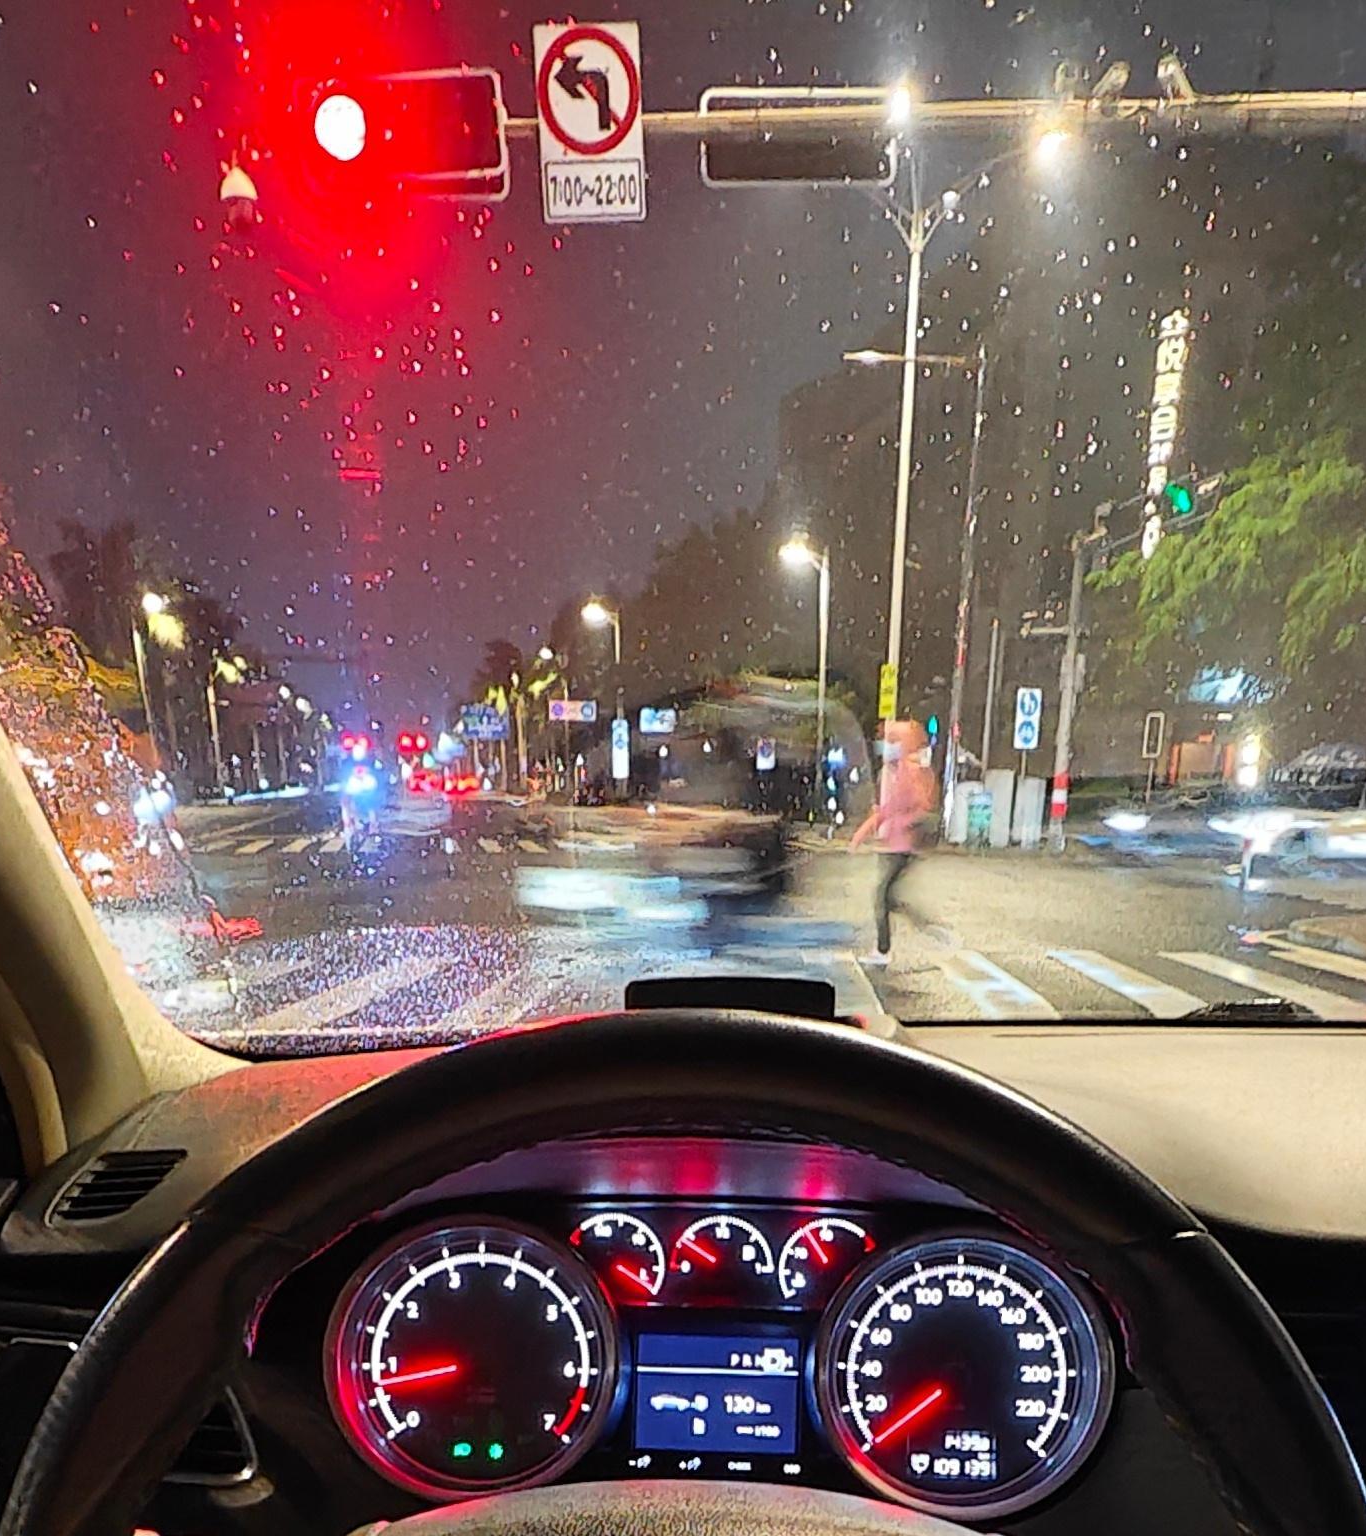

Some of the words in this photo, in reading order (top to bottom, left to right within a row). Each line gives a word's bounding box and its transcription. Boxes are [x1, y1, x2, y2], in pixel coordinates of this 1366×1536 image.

[550, 174, 636, 206] 7:00~22:00
[448, 1272, 461, 1289] 3
[503, 1273, 516, 1290] 4
[947, 1279, 974, 1298] 120
[914, 1287, 943, 1306] 100
[976, 1289, 1005, 1307] 140
[406, 1301, 420, 1319] 2
[546, 1304, 559, 1322] 5
[889, 1304, 912, 1322] 80
[999, 1307, 1027, 1325] 160
[870, 1328, 893, 1347] 60
[387, 1356, 398, 1374] 1
[563, 1361, 577, 1378] 6
[860, 1359, 883, 1378] 40
[1020, 1364, 1052, 1383] 200
[865, 1394, 888, 1412] 20
[1015, 1399, 1046, 1417] 220
[406, 1410, 420, 1428] 0
[543, 1413, 556, 1431] 7
